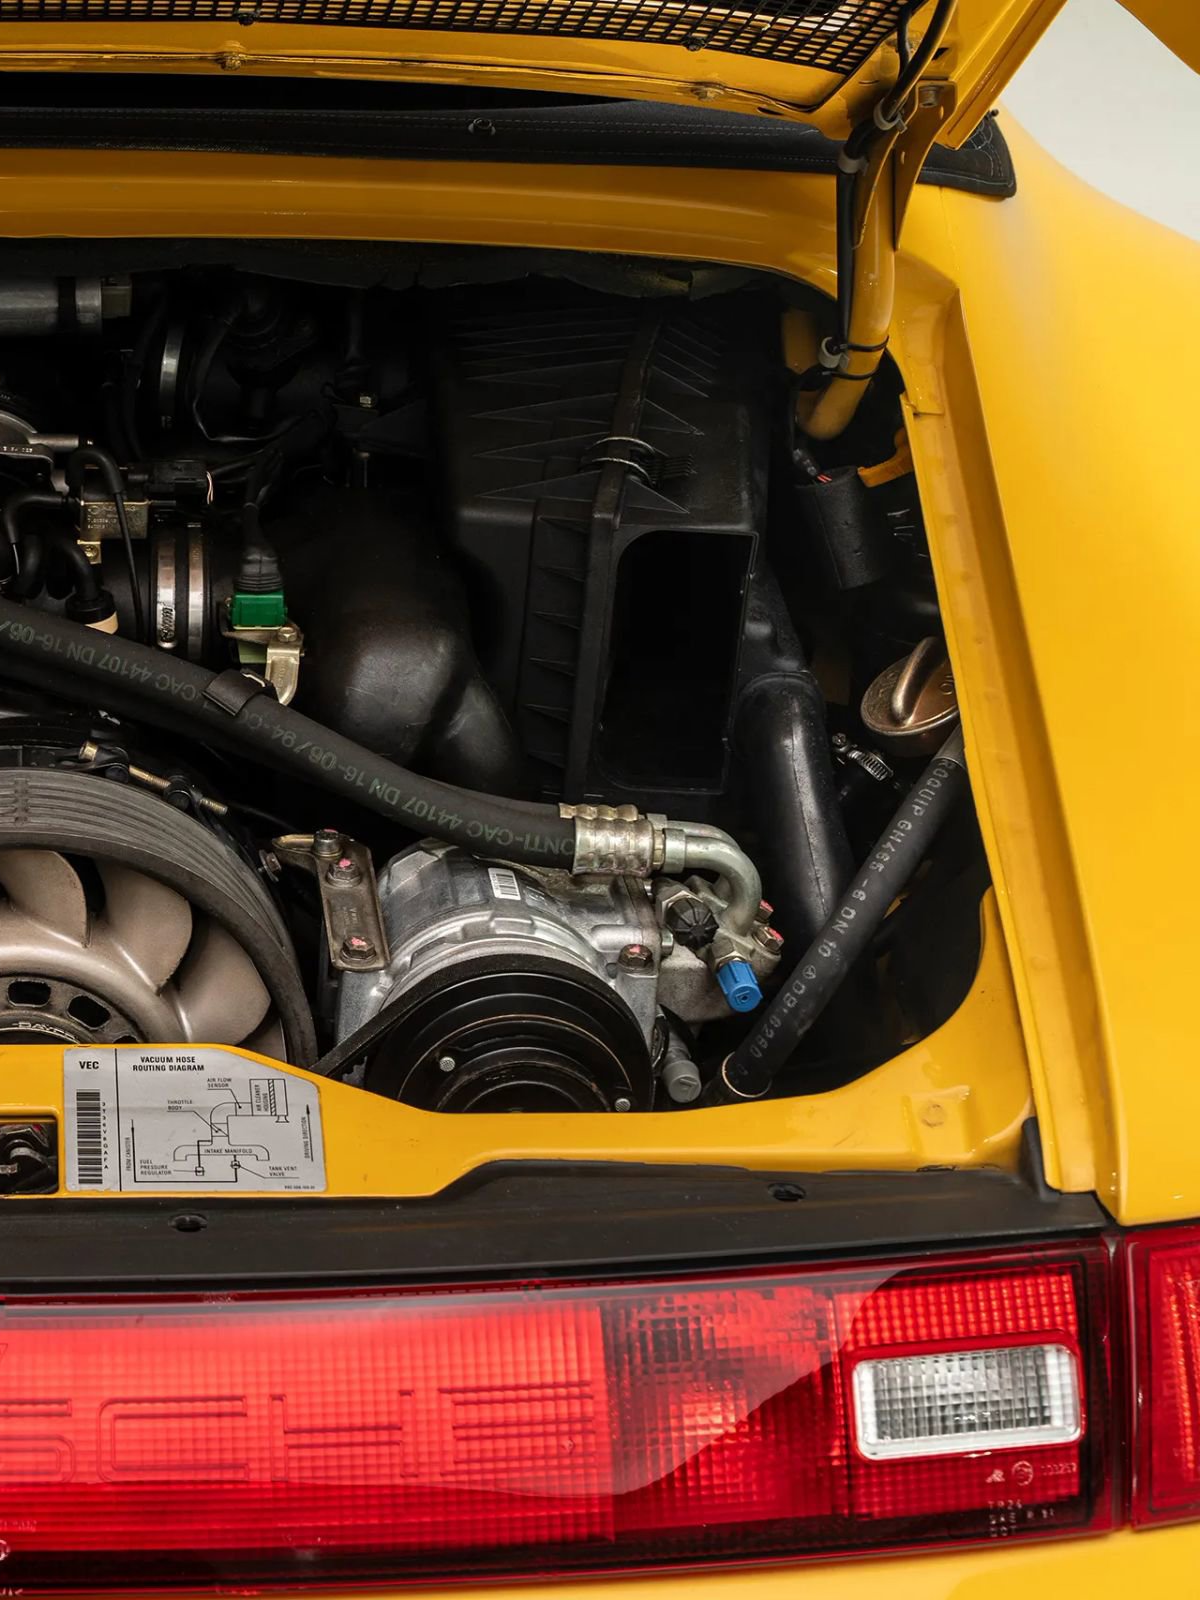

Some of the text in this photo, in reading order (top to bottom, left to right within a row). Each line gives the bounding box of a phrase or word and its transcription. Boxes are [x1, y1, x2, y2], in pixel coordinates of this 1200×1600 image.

[66, 642, 96, 665] DN
[97, 655, 152, 683] 44107
[368, 778, 401, 806] DN
[401, 796, 463, 831] 44107
[465, 820, 576, 855] ONTI-CAC
[832, 906, 857, 934] DN
[79, 1061, 100, 1070] VEC
